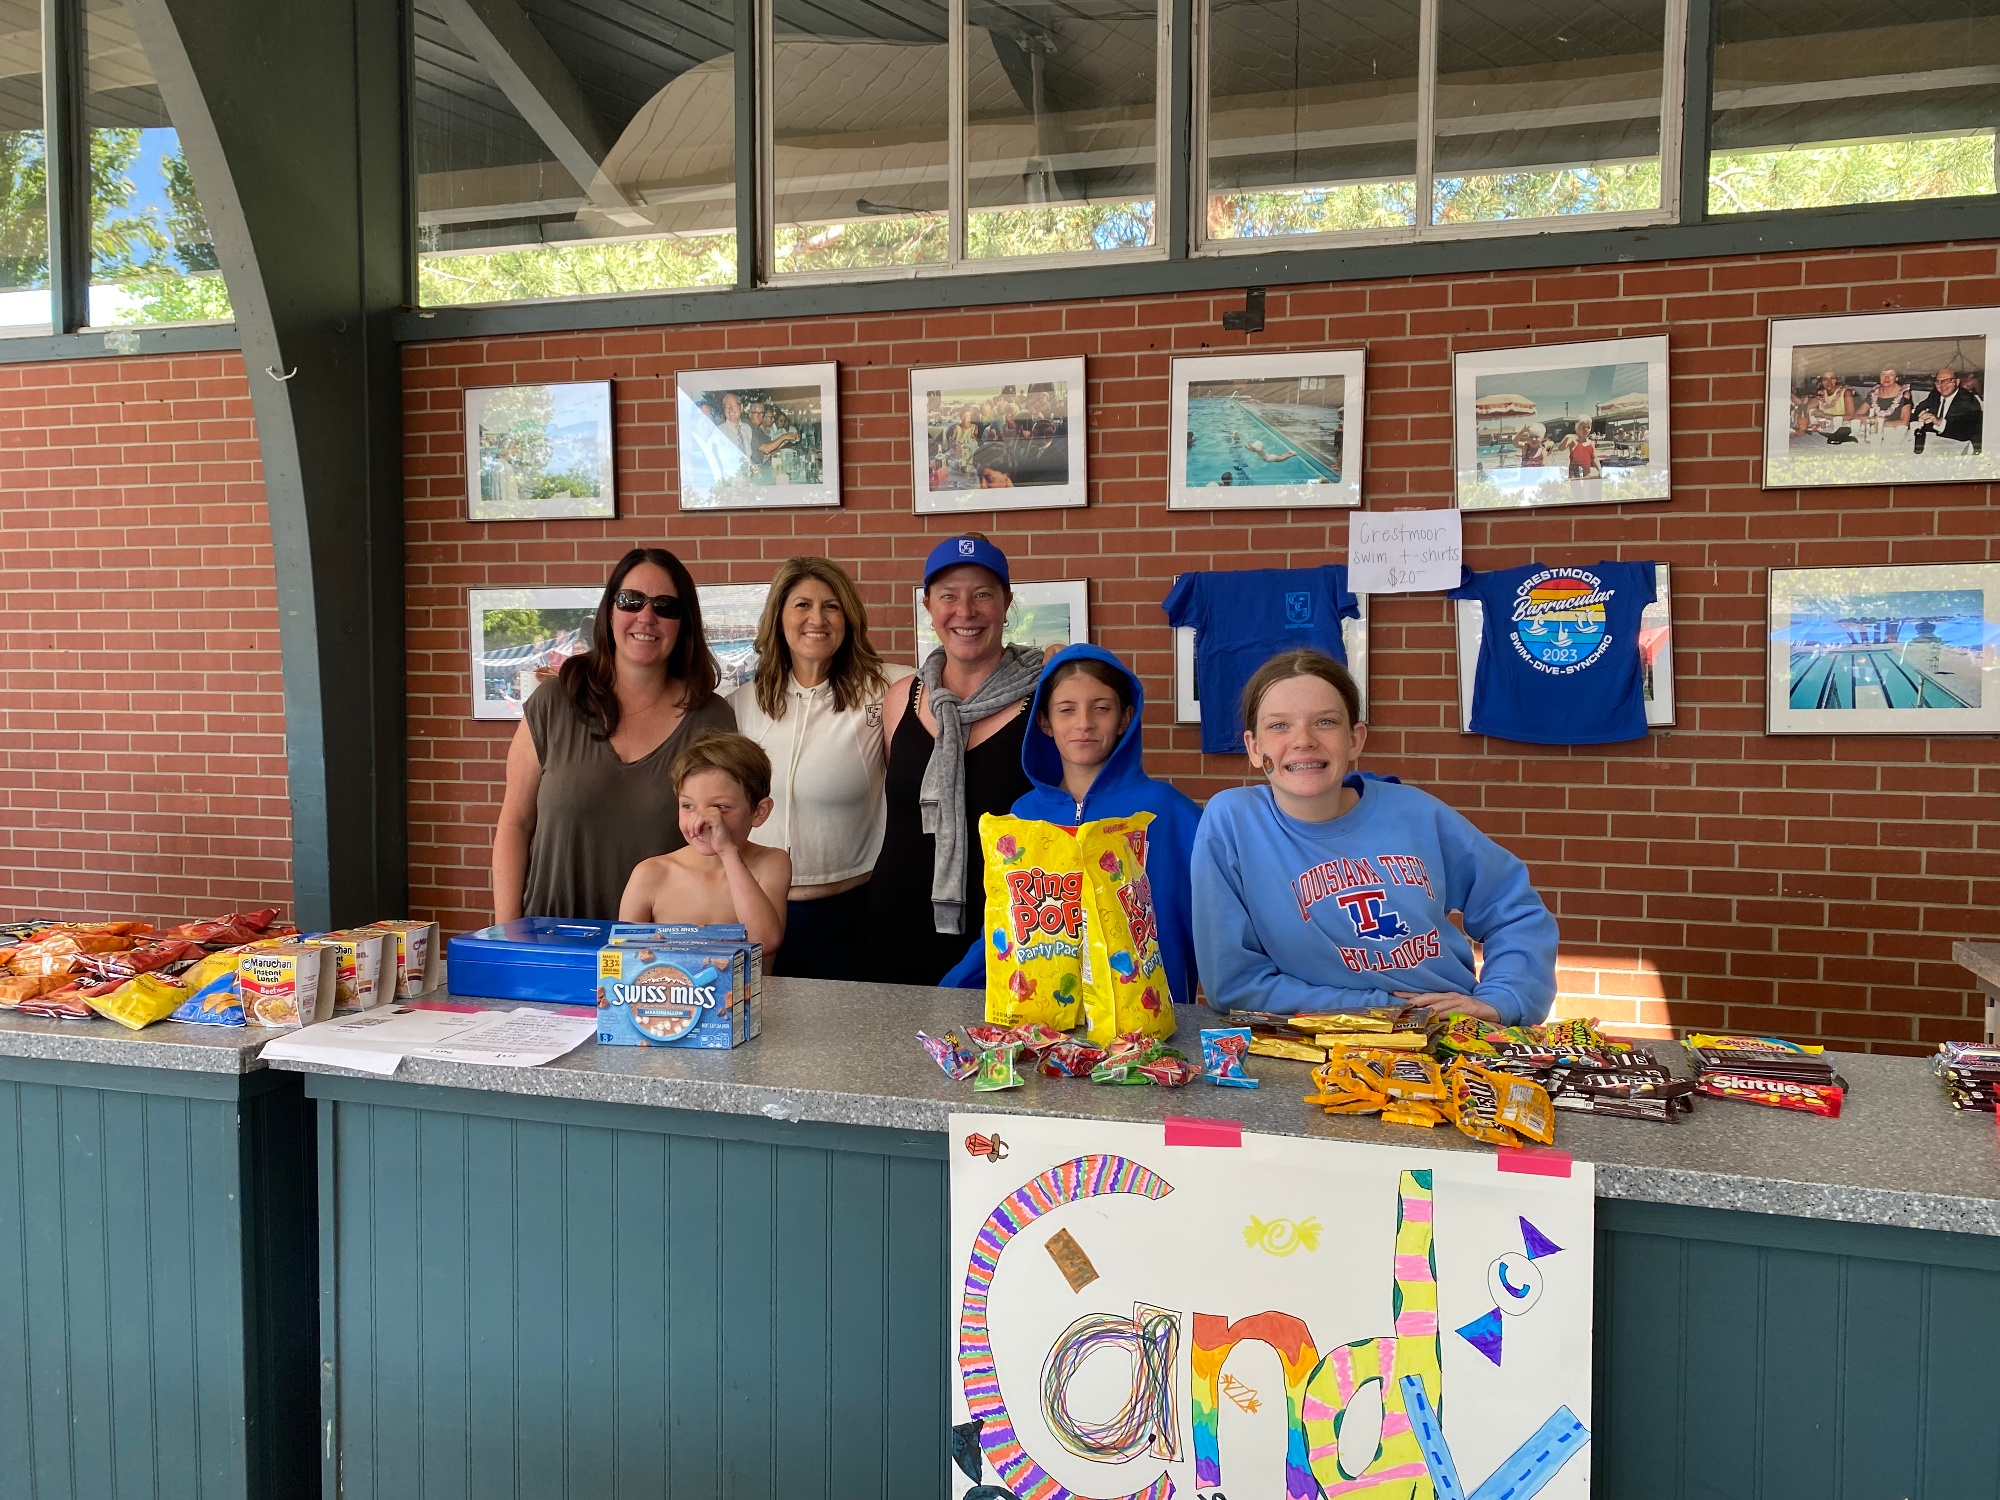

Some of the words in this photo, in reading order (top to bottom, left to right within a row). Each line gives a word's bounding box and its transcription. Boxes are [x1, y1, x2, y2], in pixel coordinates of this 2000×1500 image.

[1360, 522, 1447, 544] Crestmoor
[1353, 550, 1388, 565] swim
[1516, 567, 1602, 597] CRESTMOOR
[1511, 586, 1616, 622] Barracudas
[1542, 648, 1578, 662] 2023
[1006, 868, 1083, 909] Ring
[1376, 854, 1436, 901] TECH
[250, 958, 292, 969] Maruchan
[1016, 942, 1054, 965] Party
[1055, 941, 1079, 958] Pac
[253, 969, 282, 977] Instant
[256, 975, 279, 983] Lunch
[260, 986, 277, 995] Beef
[612, 983, 667, 1006] SWISS
[671, 986, 716, 1009] MISS
[1712, 1076, 1818, 1098] Skittles
